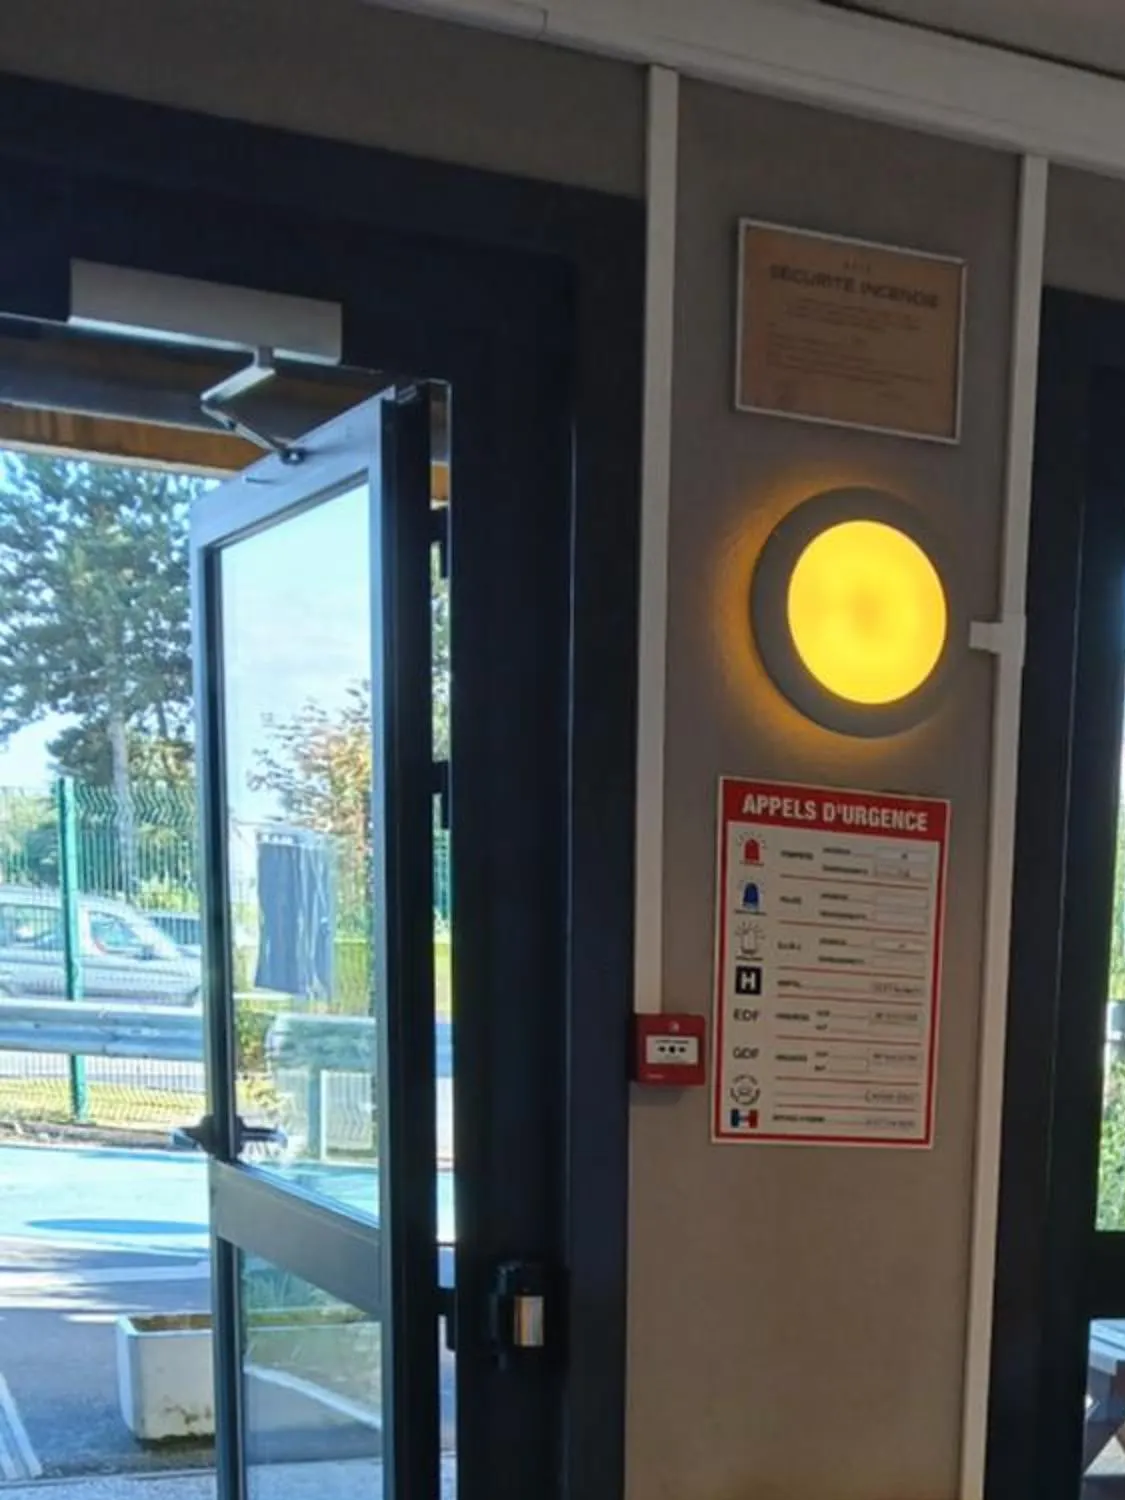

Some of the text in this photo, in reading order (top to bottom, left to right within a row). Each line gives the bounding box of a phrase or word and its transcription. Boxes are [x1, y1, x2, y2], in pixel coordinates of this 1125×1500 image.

[742, 793, 928, 832] APPELS D'URGENCE
[733, 1008, 760, 1022] EDF
[732, 1047, 759, 1060] GDF
